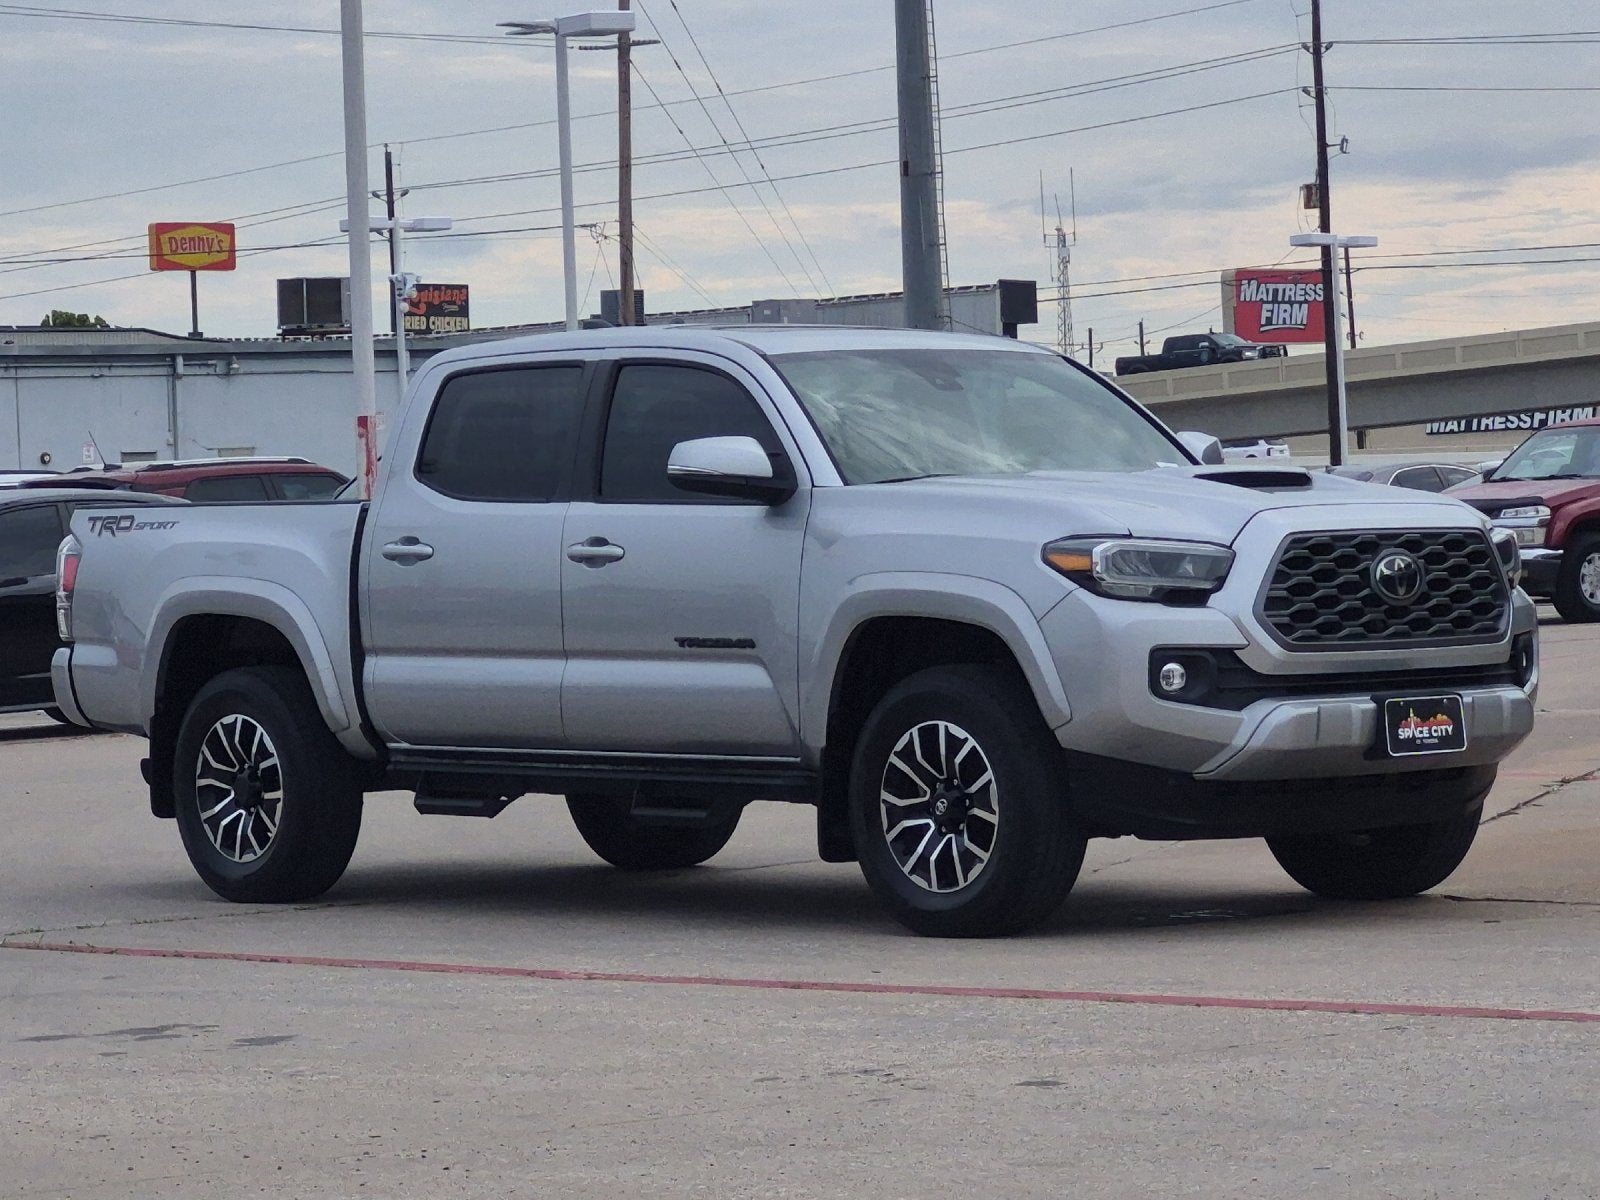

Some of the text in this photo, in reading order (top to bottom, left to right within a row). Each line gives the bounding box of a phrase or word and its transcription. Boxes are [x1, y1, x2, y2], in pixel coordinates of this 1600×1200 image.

[168, 234, 224, 256] Denny's
[1240, 279, 1324, 302] MATTRESS
[404, 315, 469, 332] RIED CHICKEN
[1260, 303, 1309, 325] FIRM
[87, 515, 180, 538] TRD SPORT
[1397, 724, 1453, 739] SPACE CITY
